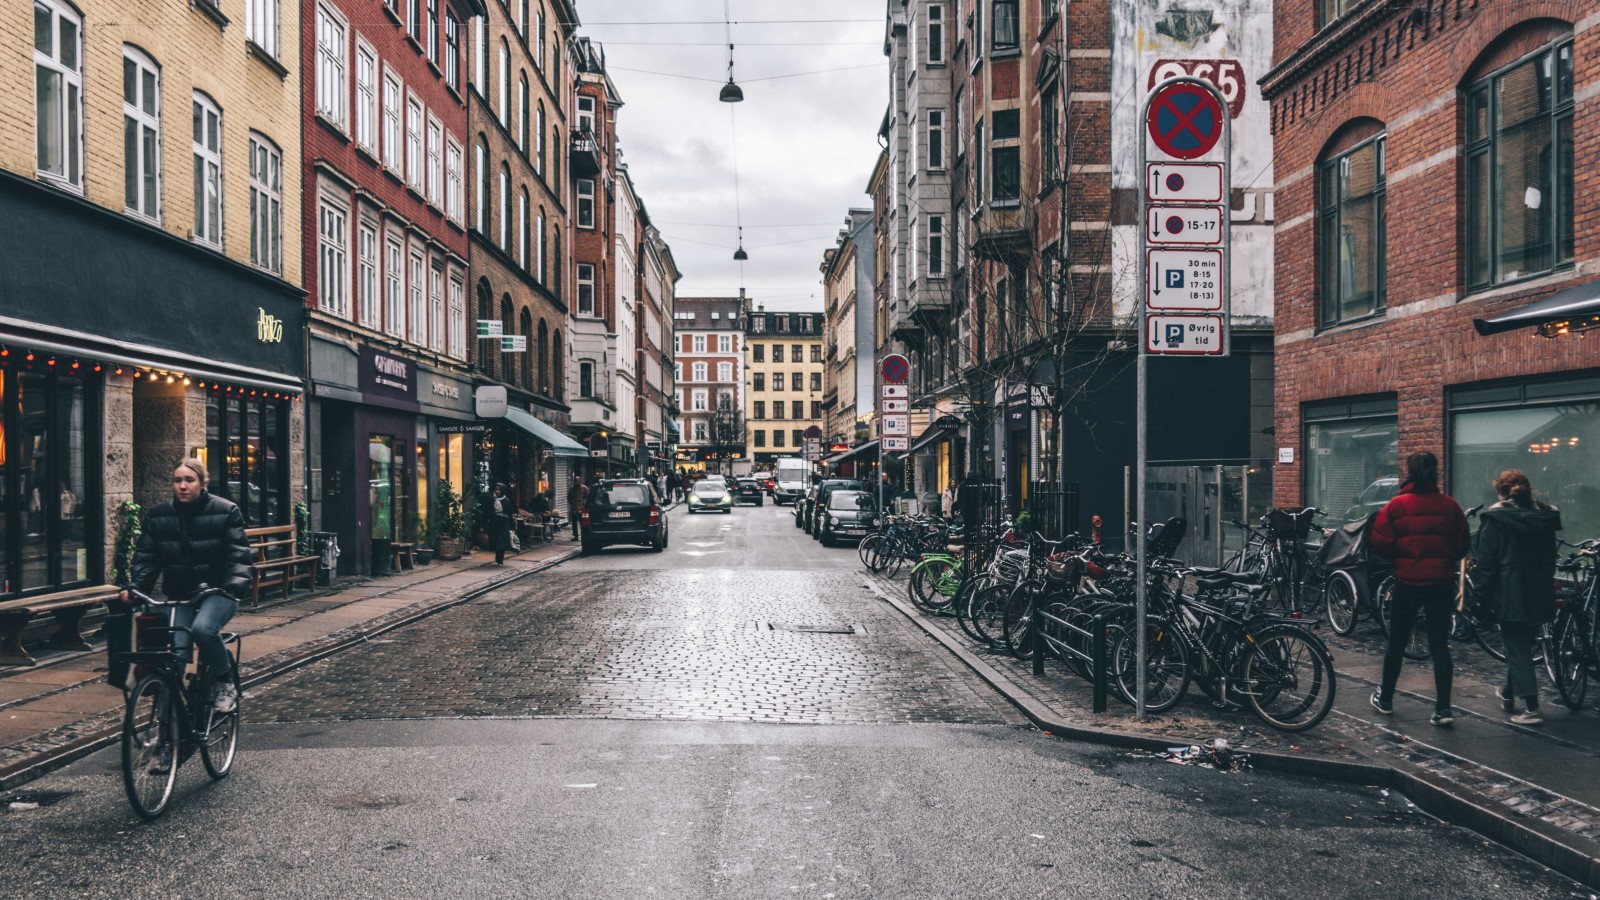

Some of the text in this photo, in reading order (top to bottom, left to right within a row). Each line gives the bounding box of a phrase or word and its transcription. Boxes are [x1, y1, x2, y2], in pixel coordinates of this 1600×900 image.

[1187, 221, 1216, 230] 15-17
[1188, 259, 1200, 267] 30
[1188, 323, 1215, 334] Øvrig
[1195, 336, 1209, 345] tid
